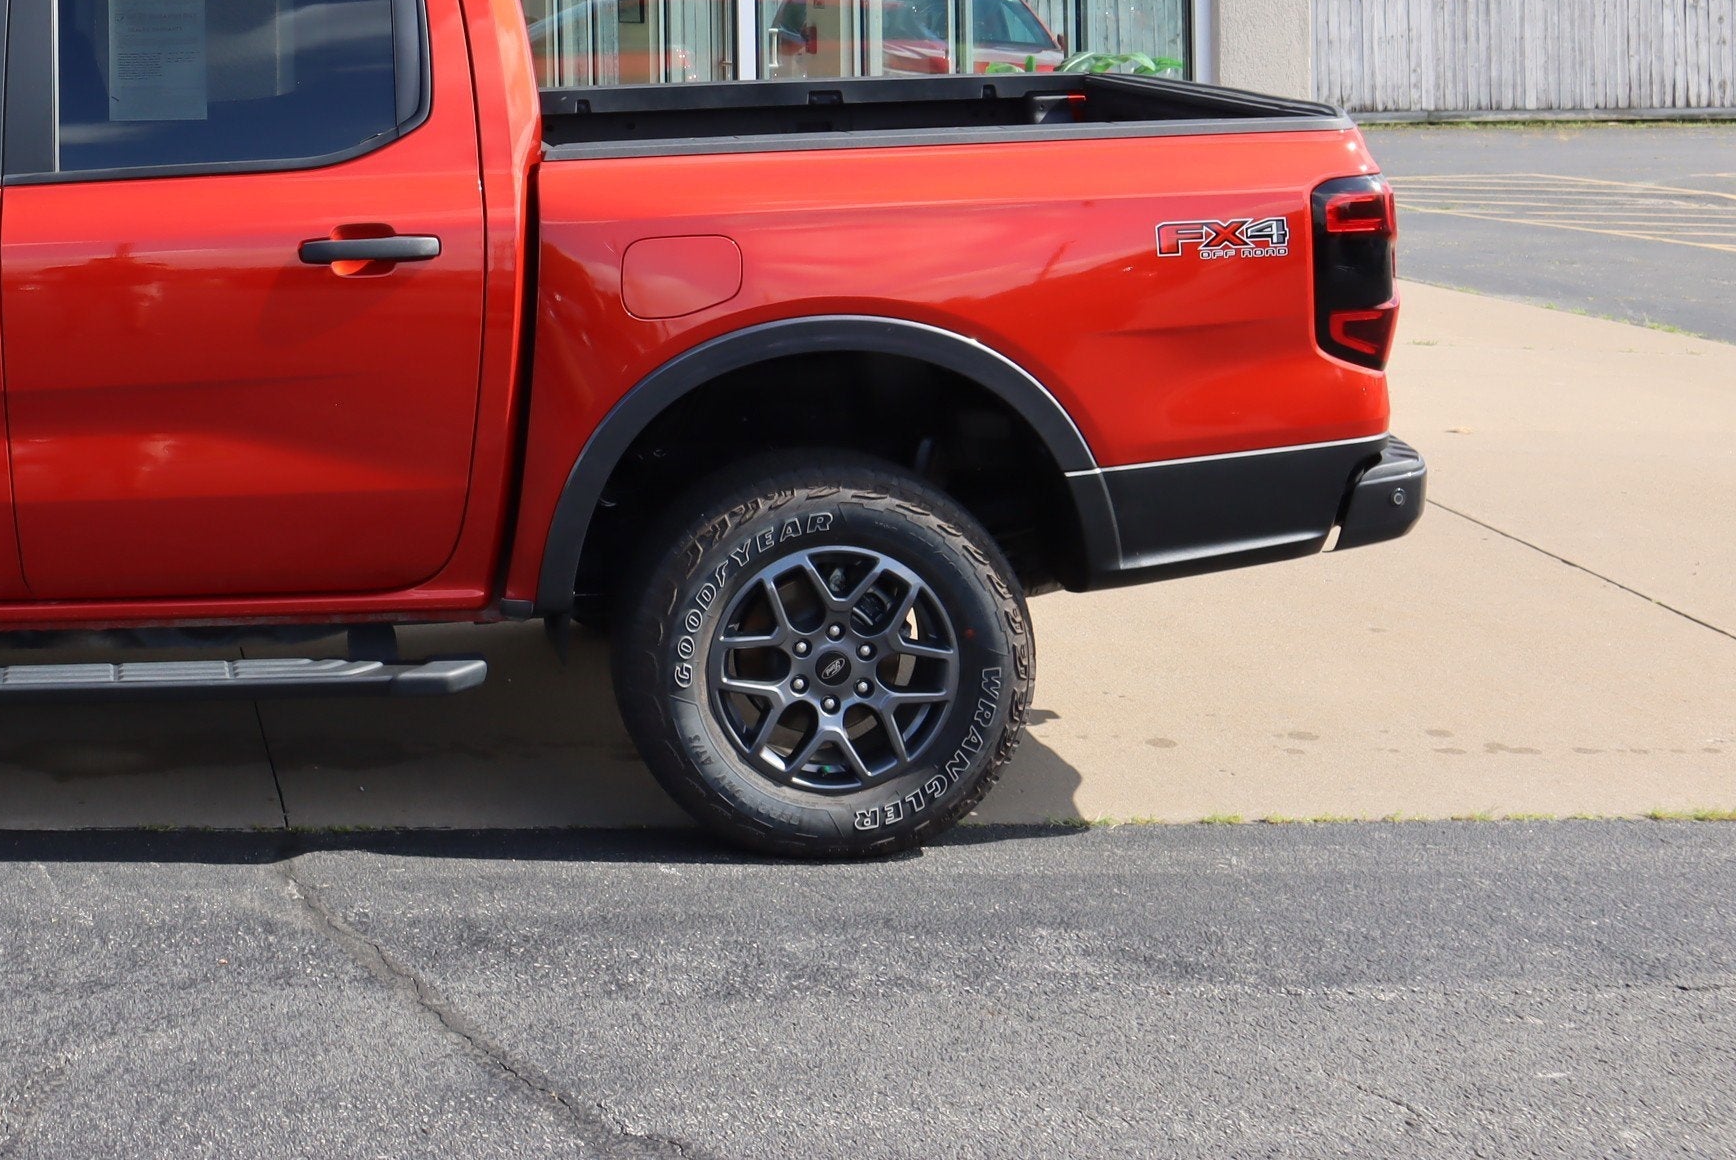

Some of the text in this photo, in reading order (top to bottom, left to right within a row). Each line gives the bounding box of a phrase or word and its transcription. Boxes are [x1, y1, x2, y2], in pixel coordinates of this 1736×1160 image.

[1155, 216, 1289, 257] FX4
[1200, 246, 1288, 260] OFF ROAD
[673, 511, 833, 688] GOODYEAR
[853, 666, 1002, 830] WRANGLER
